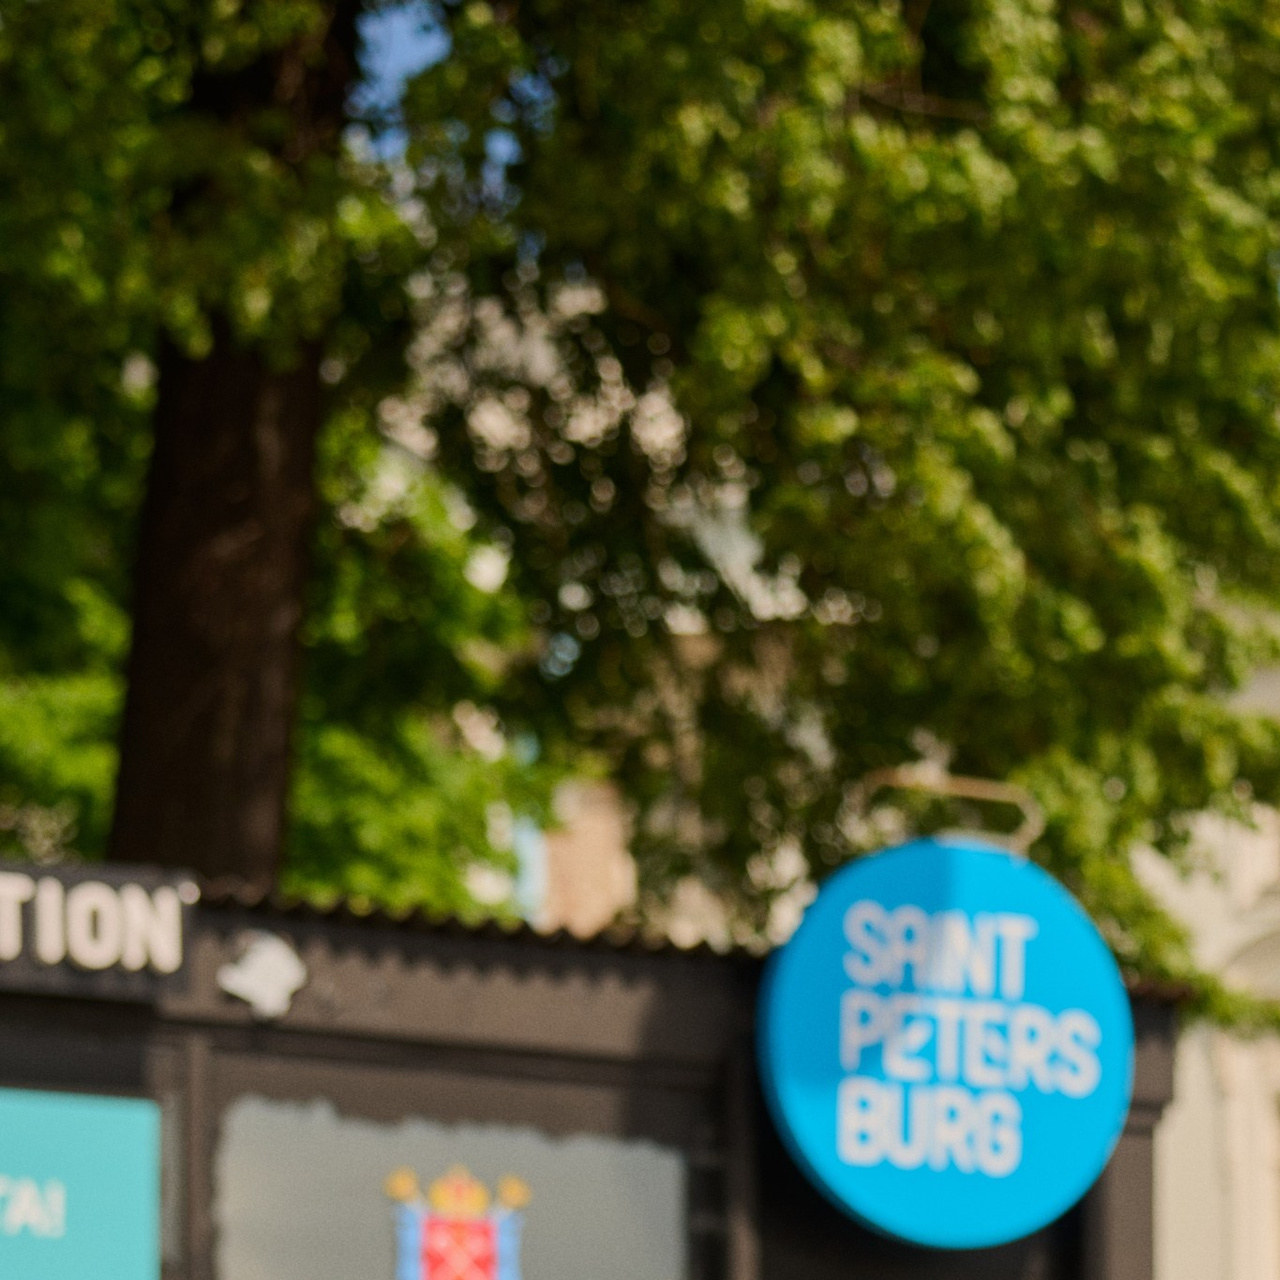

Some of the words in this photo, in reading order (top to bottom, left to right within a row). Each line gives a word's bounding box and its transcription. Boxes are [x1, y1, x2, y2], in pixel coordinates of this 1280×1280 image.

[842, 900, 1038, 1001] SAINT
[839, 988, 1101, 1099] PETERS
[836, 1075, 1023, 1178] BURG
